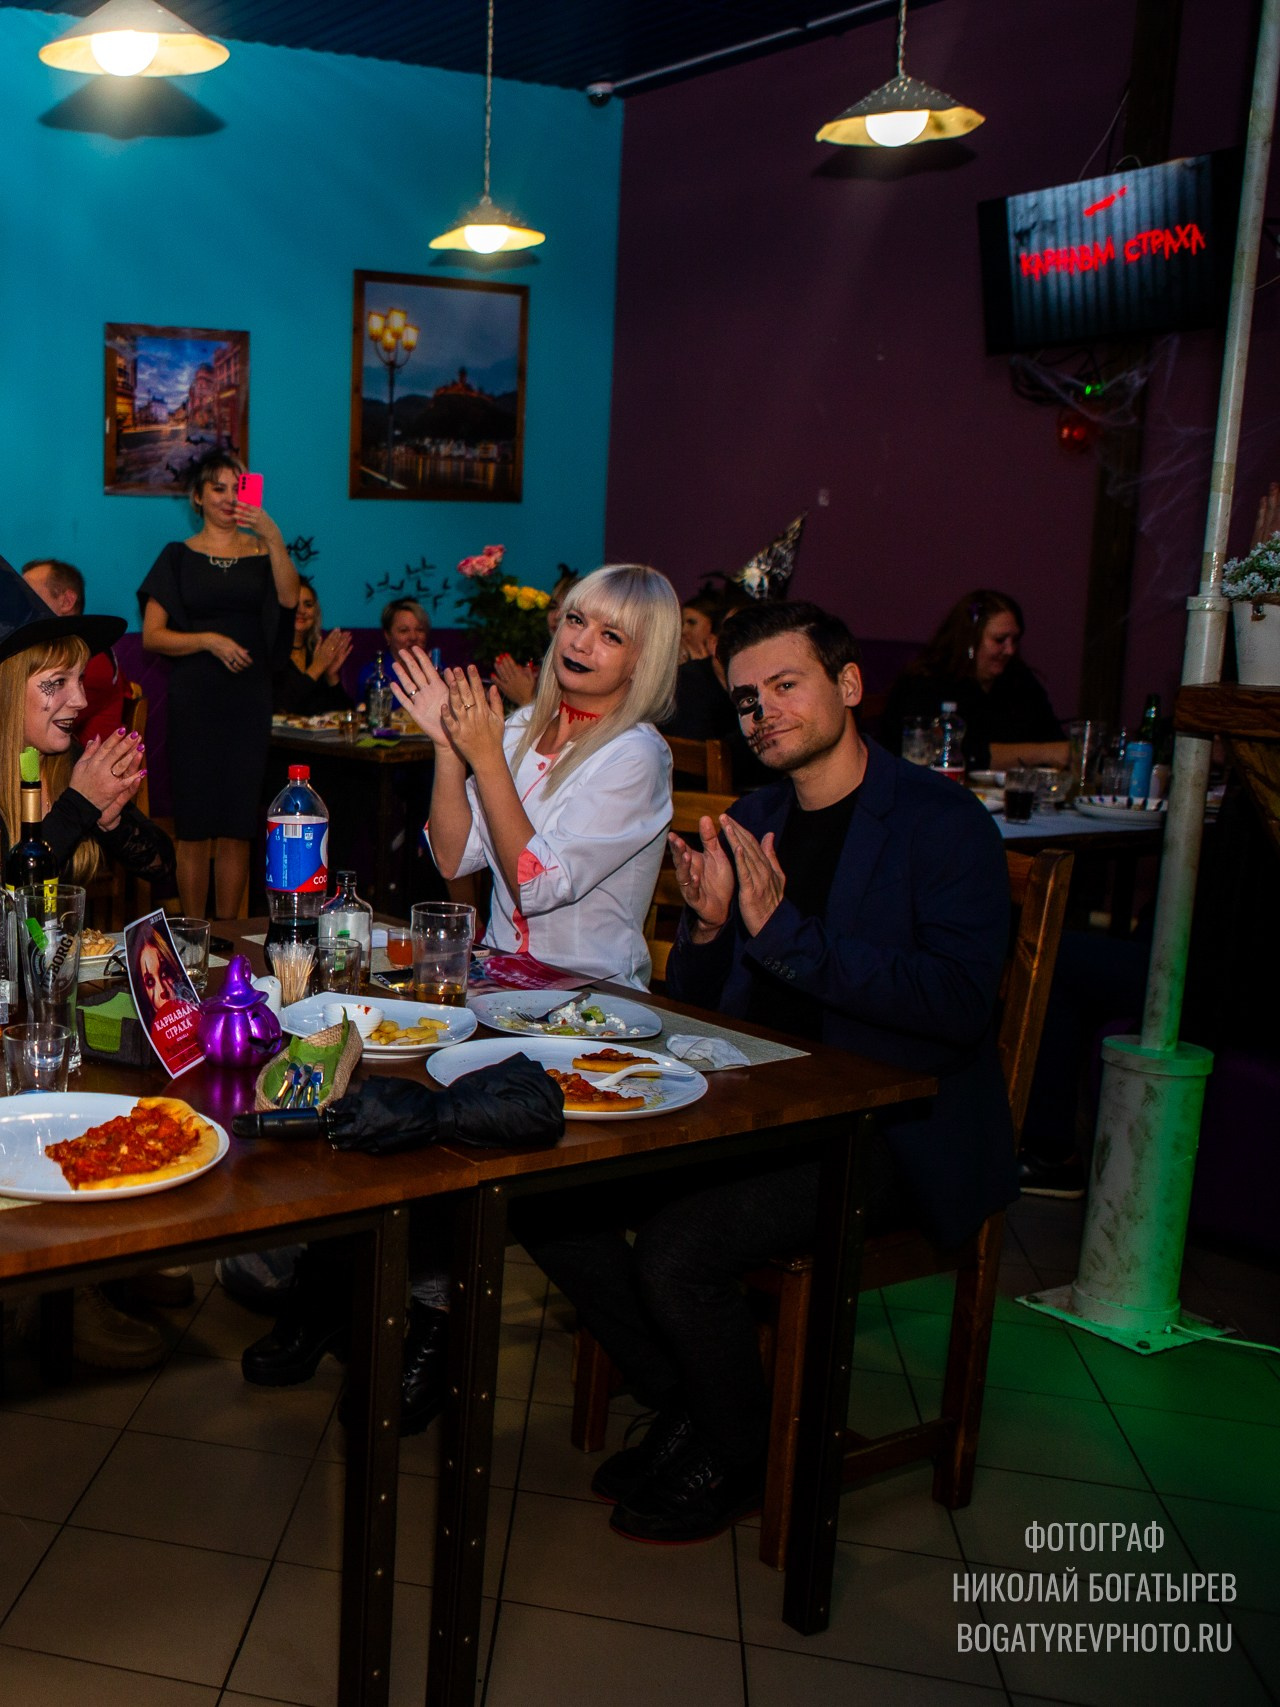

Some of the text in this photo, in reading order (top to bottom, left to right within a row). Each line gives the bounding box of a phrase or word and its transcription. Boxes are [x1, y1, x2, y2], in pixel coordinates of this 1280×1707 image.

[1123, 222, 1207, 265] СТРАХА
[39, 936, 74, 989] TUBORG
[153, 1004, 193, 1031] КАРНАВАЛ
[165, 1018, 193, 1040] СТРАХА
